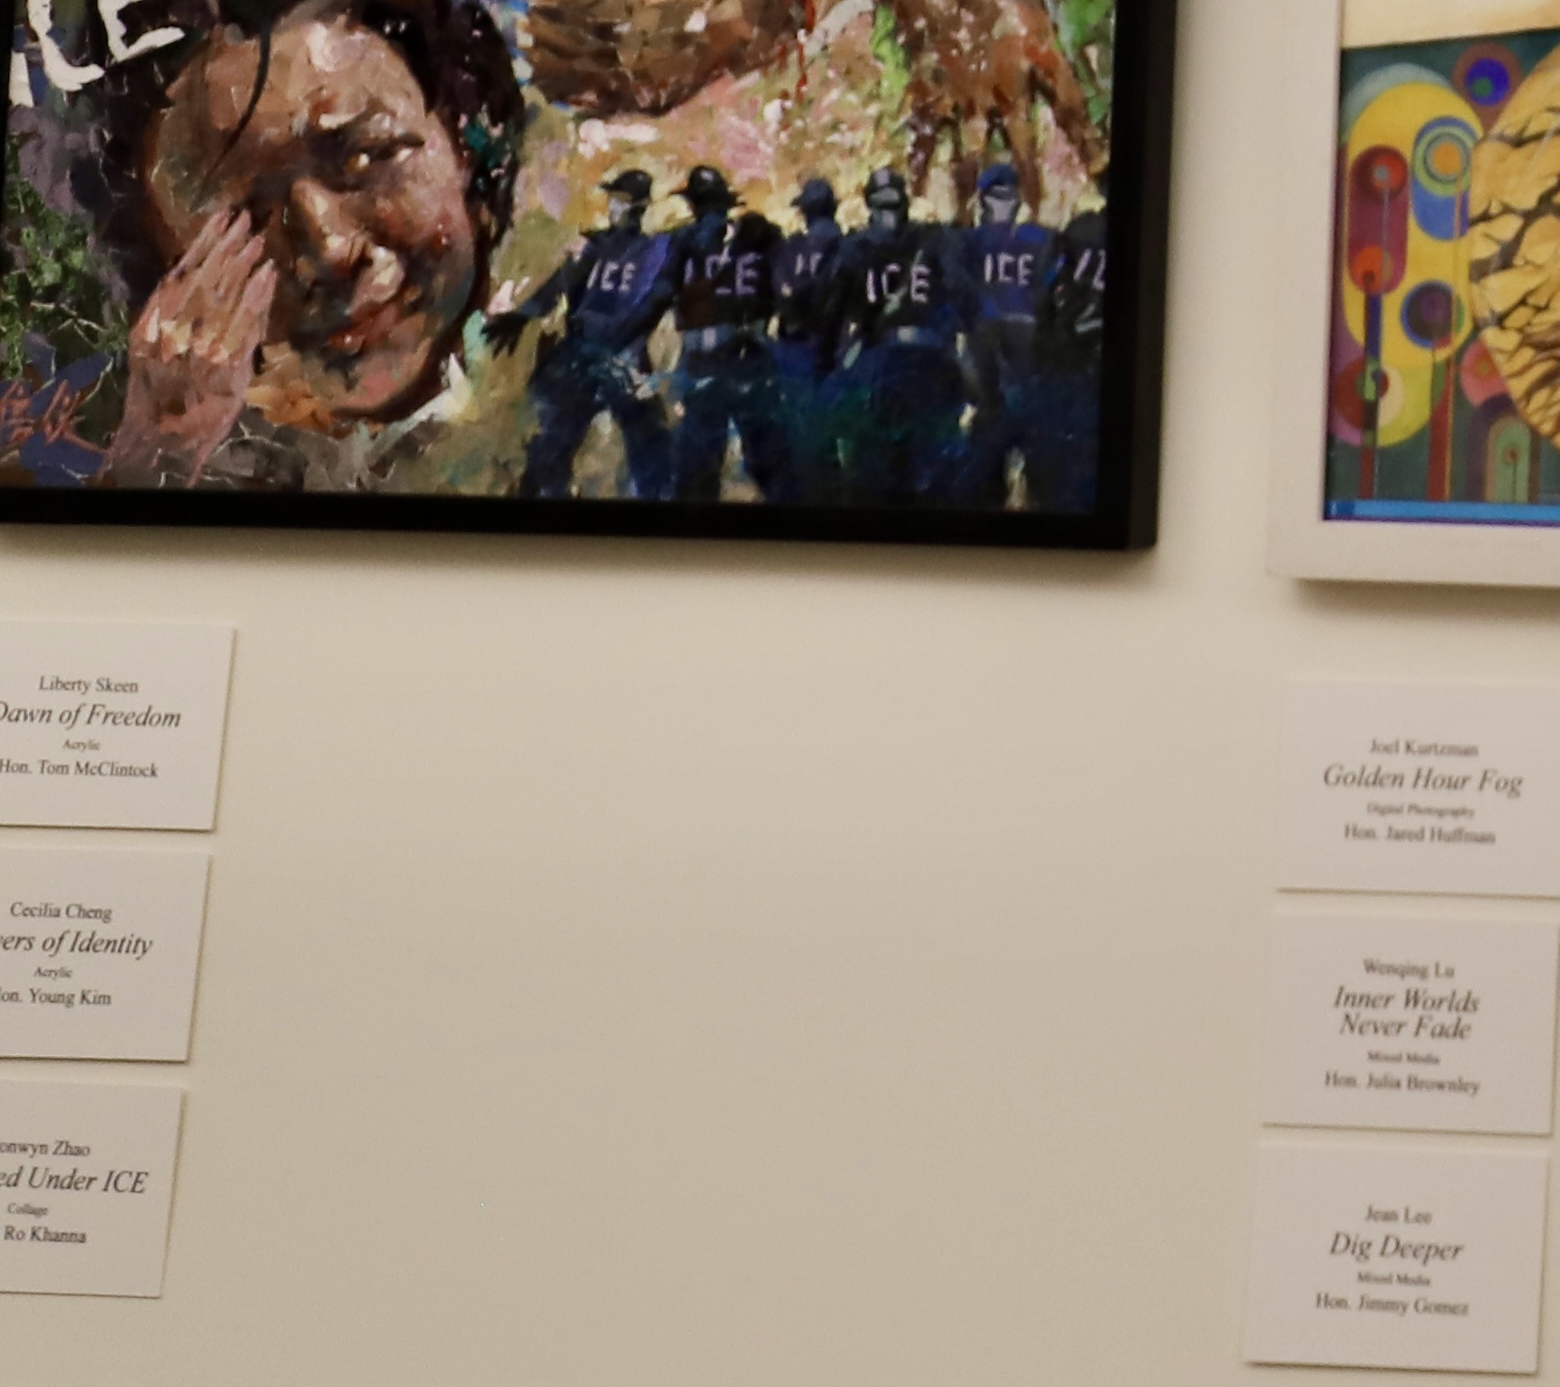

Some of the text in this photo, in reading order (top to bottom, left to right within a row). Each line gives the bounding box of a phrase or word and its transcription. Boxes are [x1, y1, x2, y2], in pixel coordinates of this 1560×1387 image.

[587, 259, 636, 292] ICE
[984, 253, 1034, 286] ICE
[866, 263, 931, 303] ICE
[38, 675, 139, 695] Liberty Skeen
[59, 702, 86, 730] of
[85, 704, 182, 729] Freedom
[62, 738, 100, 752] Acrylic
[1369, 738, 1479, 757] Joel Kurtzman
[0, 758, 159, 778] Hon. Tom McClintock
[1323, 762, 1524, 799] Golden Hour Fog
[1344, 824, 1496, 844] Hon. Jared Huffman
[10, 901, 113, 924] Cecilia Cheng
[0, 930, 155, 961] ers of Identity
[33, 966, 73, 980] Acrylic
[0, 987, 113, 1008] on. Young Kim
[1333, 984, 1480, 1013] Inner Worlds
[1339, 1011, 1473, 1040] Never Fade
[1324, 1070, 1480, 1097] Hon. Julia Brownley
[0, 1140, 90, 1158] onwyn Zhao
[0, 1165, 149, 1194] ed Under ICE
[1404, 1206, 1433, 1224] Lee
[4, 1225, 87, 1243] Ro Khanna
[1330, 1231, 1465, 1266] Dig Deeper
[1316, 1291, 1470, 1316] Hon. Jimmy Gomez
